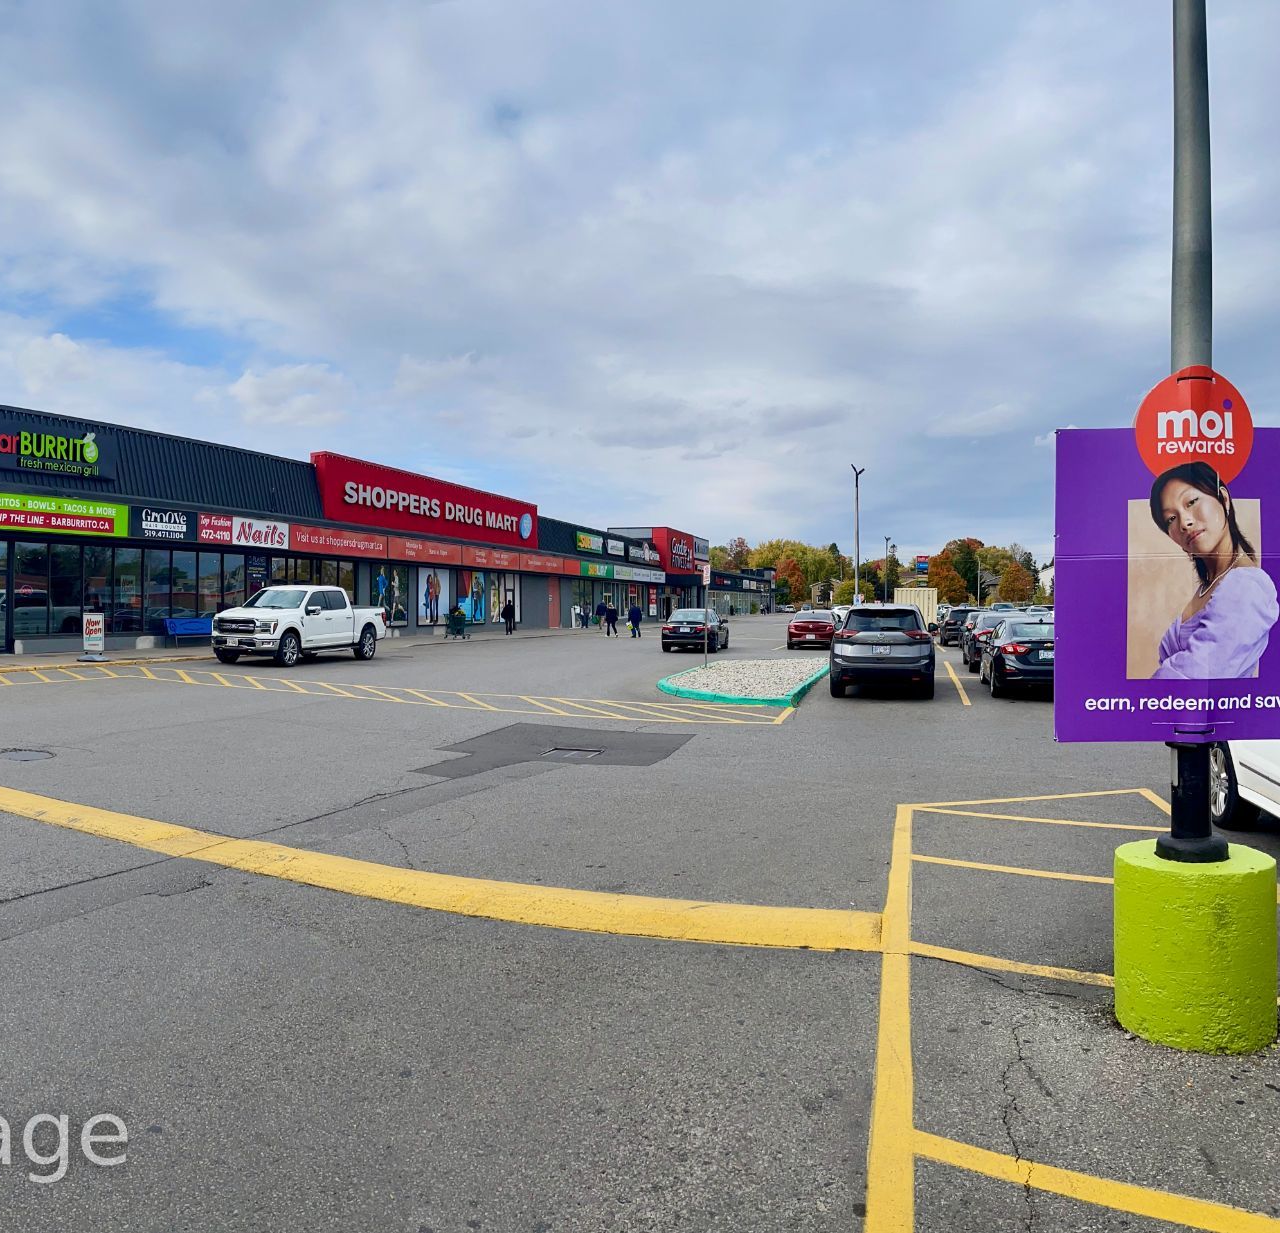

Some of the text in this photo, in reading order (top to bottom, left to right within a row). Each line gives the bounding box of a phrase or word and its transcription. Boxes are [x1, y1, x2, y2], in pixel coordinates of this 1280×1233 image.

[1157, 398, 1233, 439] moi
[1157, 438, 1235, 455] rewards
[20, 457, 99, 477] fresh mexican grill
[27, 500, 56, 511] BOWLS
[63, 503, 87, 514] TACOS
[88, 506, 95, 514] &
[96, 506, 117, 516] MORE
[344, 481, 519, 533] SHOPPERS DRUG MART
[10, 513, 25, 524] THE
[27, 515, 44, 525] LINE
[51, 516, 110, 530] BARBURRITO.CA
[200, 515, 210, 526] Top
[200, 529, 231, 541] 472-4110
[236, 521, 286, 547] Nails
[296, 532, 310, 543] Visit
[311, 535, 319, 544] us
[319, 536, 326, 544] at
[85, 617, 101, 627] Now
[84, 626, 102, 638] Open
[1084, 697, 1136, 713] earn,
[1139, 695, 1215, 711] redeem
[1217, 694, 1251, 710] and
